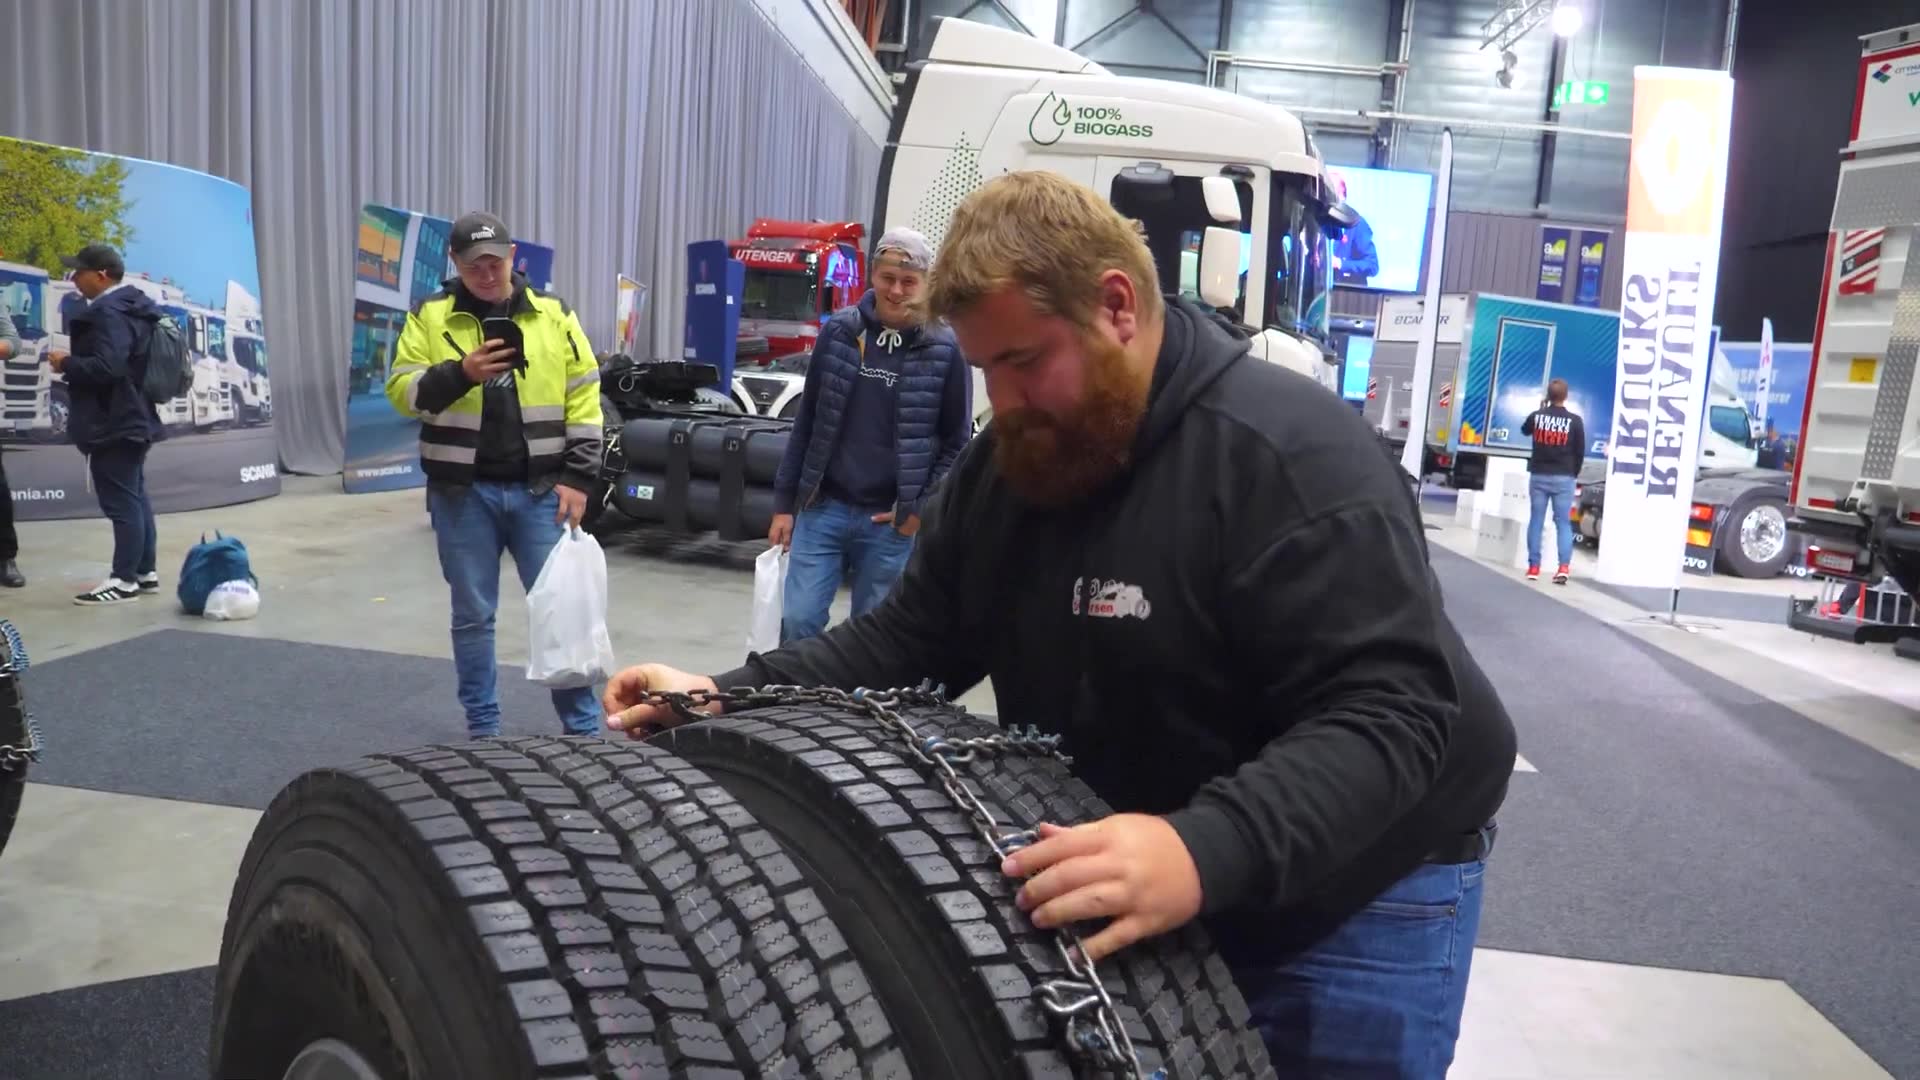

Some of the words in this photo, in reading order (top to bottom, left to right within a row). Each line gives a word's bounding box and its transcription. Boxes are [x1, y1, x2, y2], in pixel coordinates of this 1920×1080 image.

[1077, 107, 1122, 120] 100%
[1074, 122, 1153, 137] BIOGASS
[735, 249, 795, 263] UTENGEN
[240, 464, 276, 483] SCANIA
